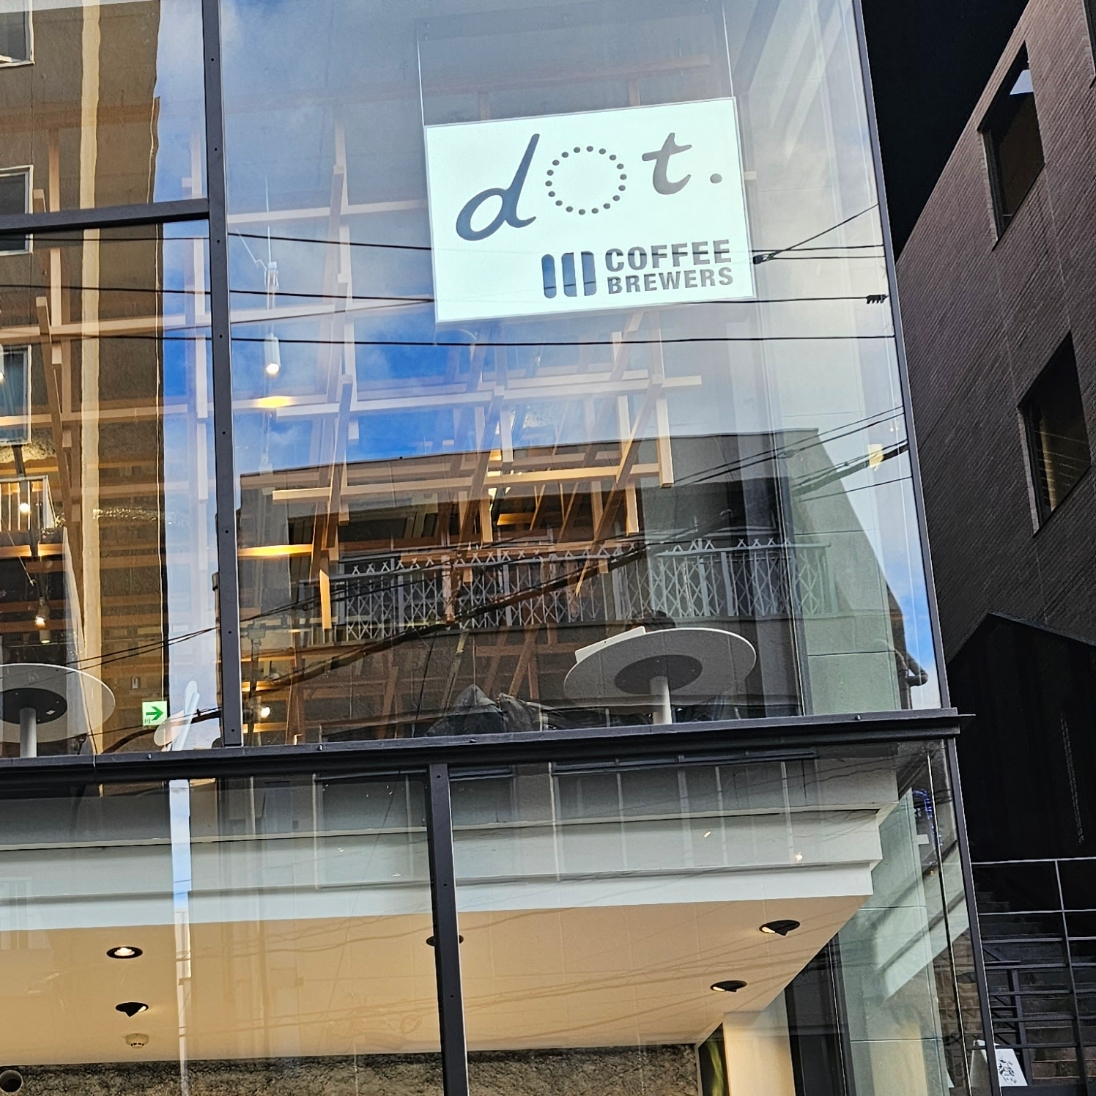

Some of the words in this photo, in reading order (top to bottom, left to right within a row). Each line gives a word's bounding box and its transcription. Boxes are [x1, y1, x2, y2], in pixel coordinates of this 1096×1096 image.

[456, 132, 723, 241] dot.
[605, 239, 732, 272] COFFEE
[607, 267, 734, 295] BREWERS
